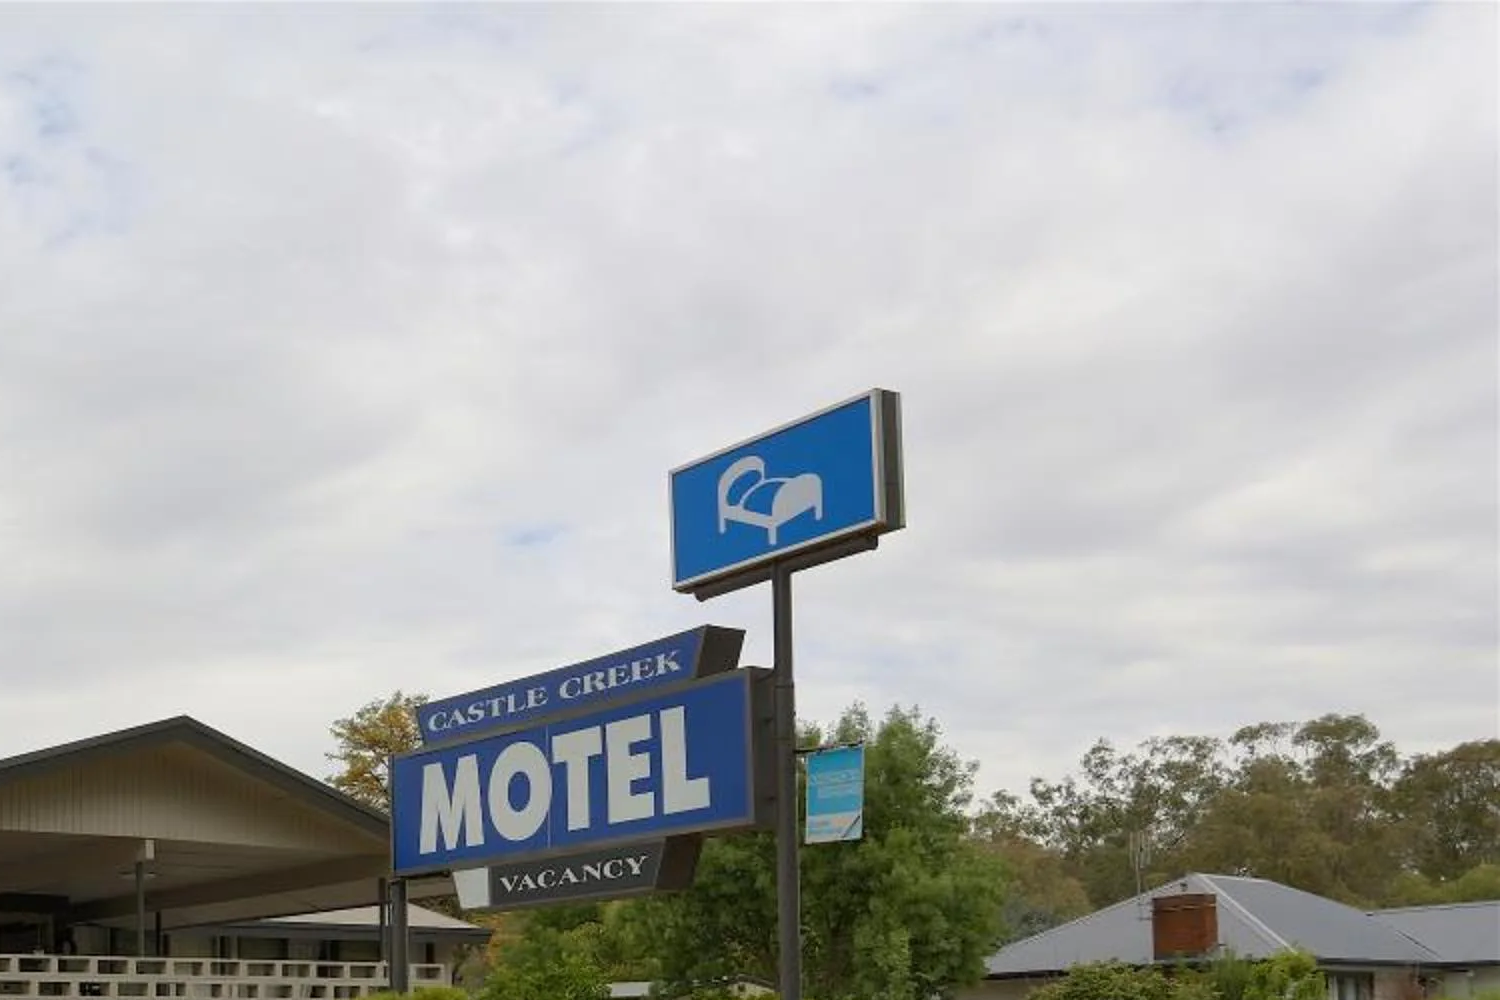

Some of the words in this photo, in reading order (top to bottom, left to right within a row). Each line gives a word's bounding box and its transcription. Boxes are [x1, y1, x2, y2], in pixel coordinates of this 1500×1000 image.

[428, 686, 548, 733] CASTLE
[559, 650, 681, 699] CREEK
[419, 705, 711, 855] MOTEL
[499, 854, 650, 896] VACANCY
